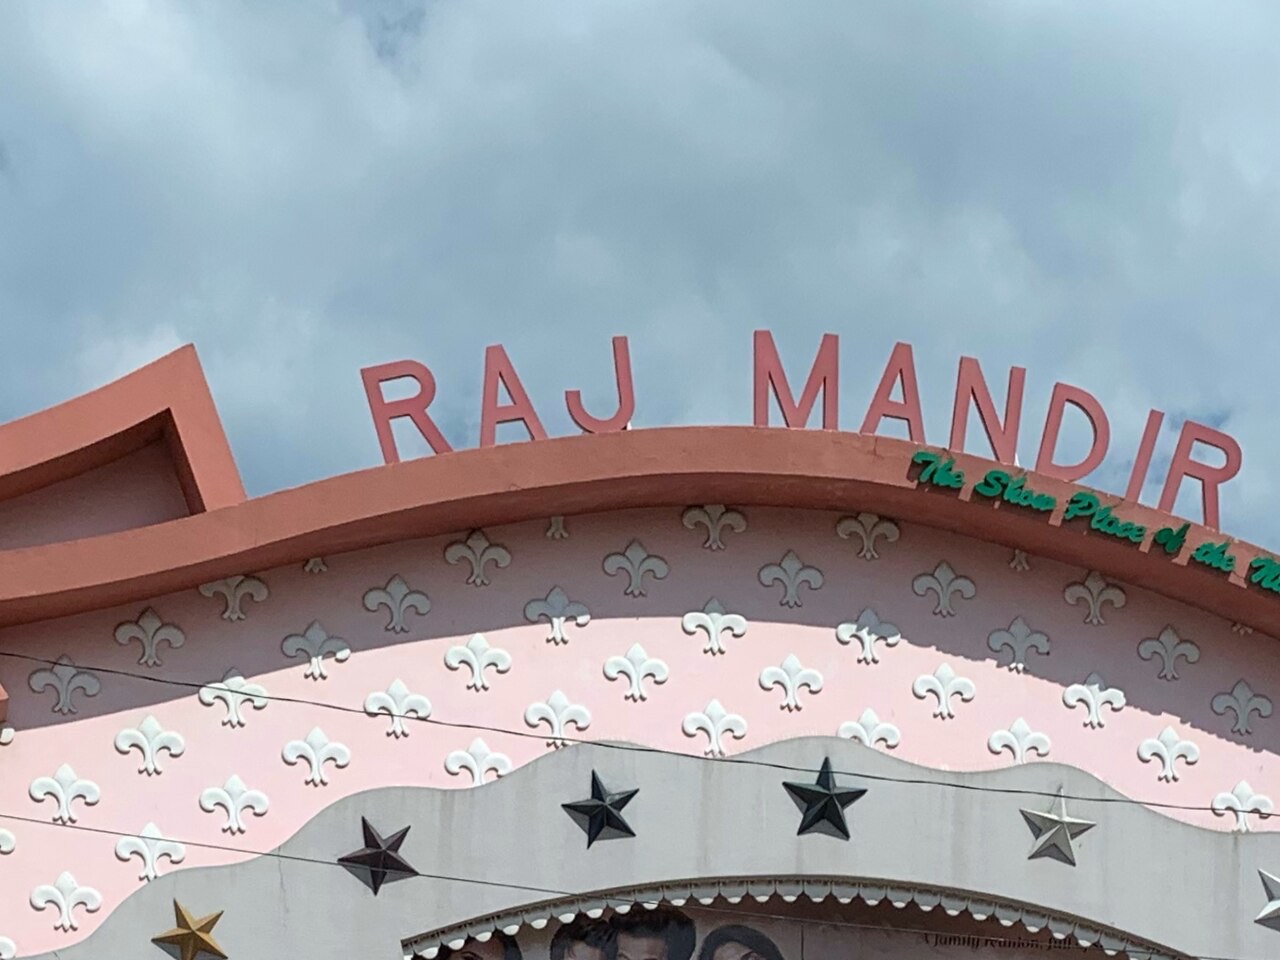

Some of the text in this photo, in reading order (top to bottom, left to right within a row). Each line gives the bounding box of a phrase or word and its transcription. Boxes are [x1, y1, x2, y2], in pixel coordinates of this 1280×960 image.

[359, 330, 1244, 532] RAJ MANDIR
[912, 450, 966, 490] The
[975, 470, 1058, 511] Show
[1065, 491, 1147, 543] Place
[1155, 522, 1193, 554] of
[1191, 540, 1237, 573] the
